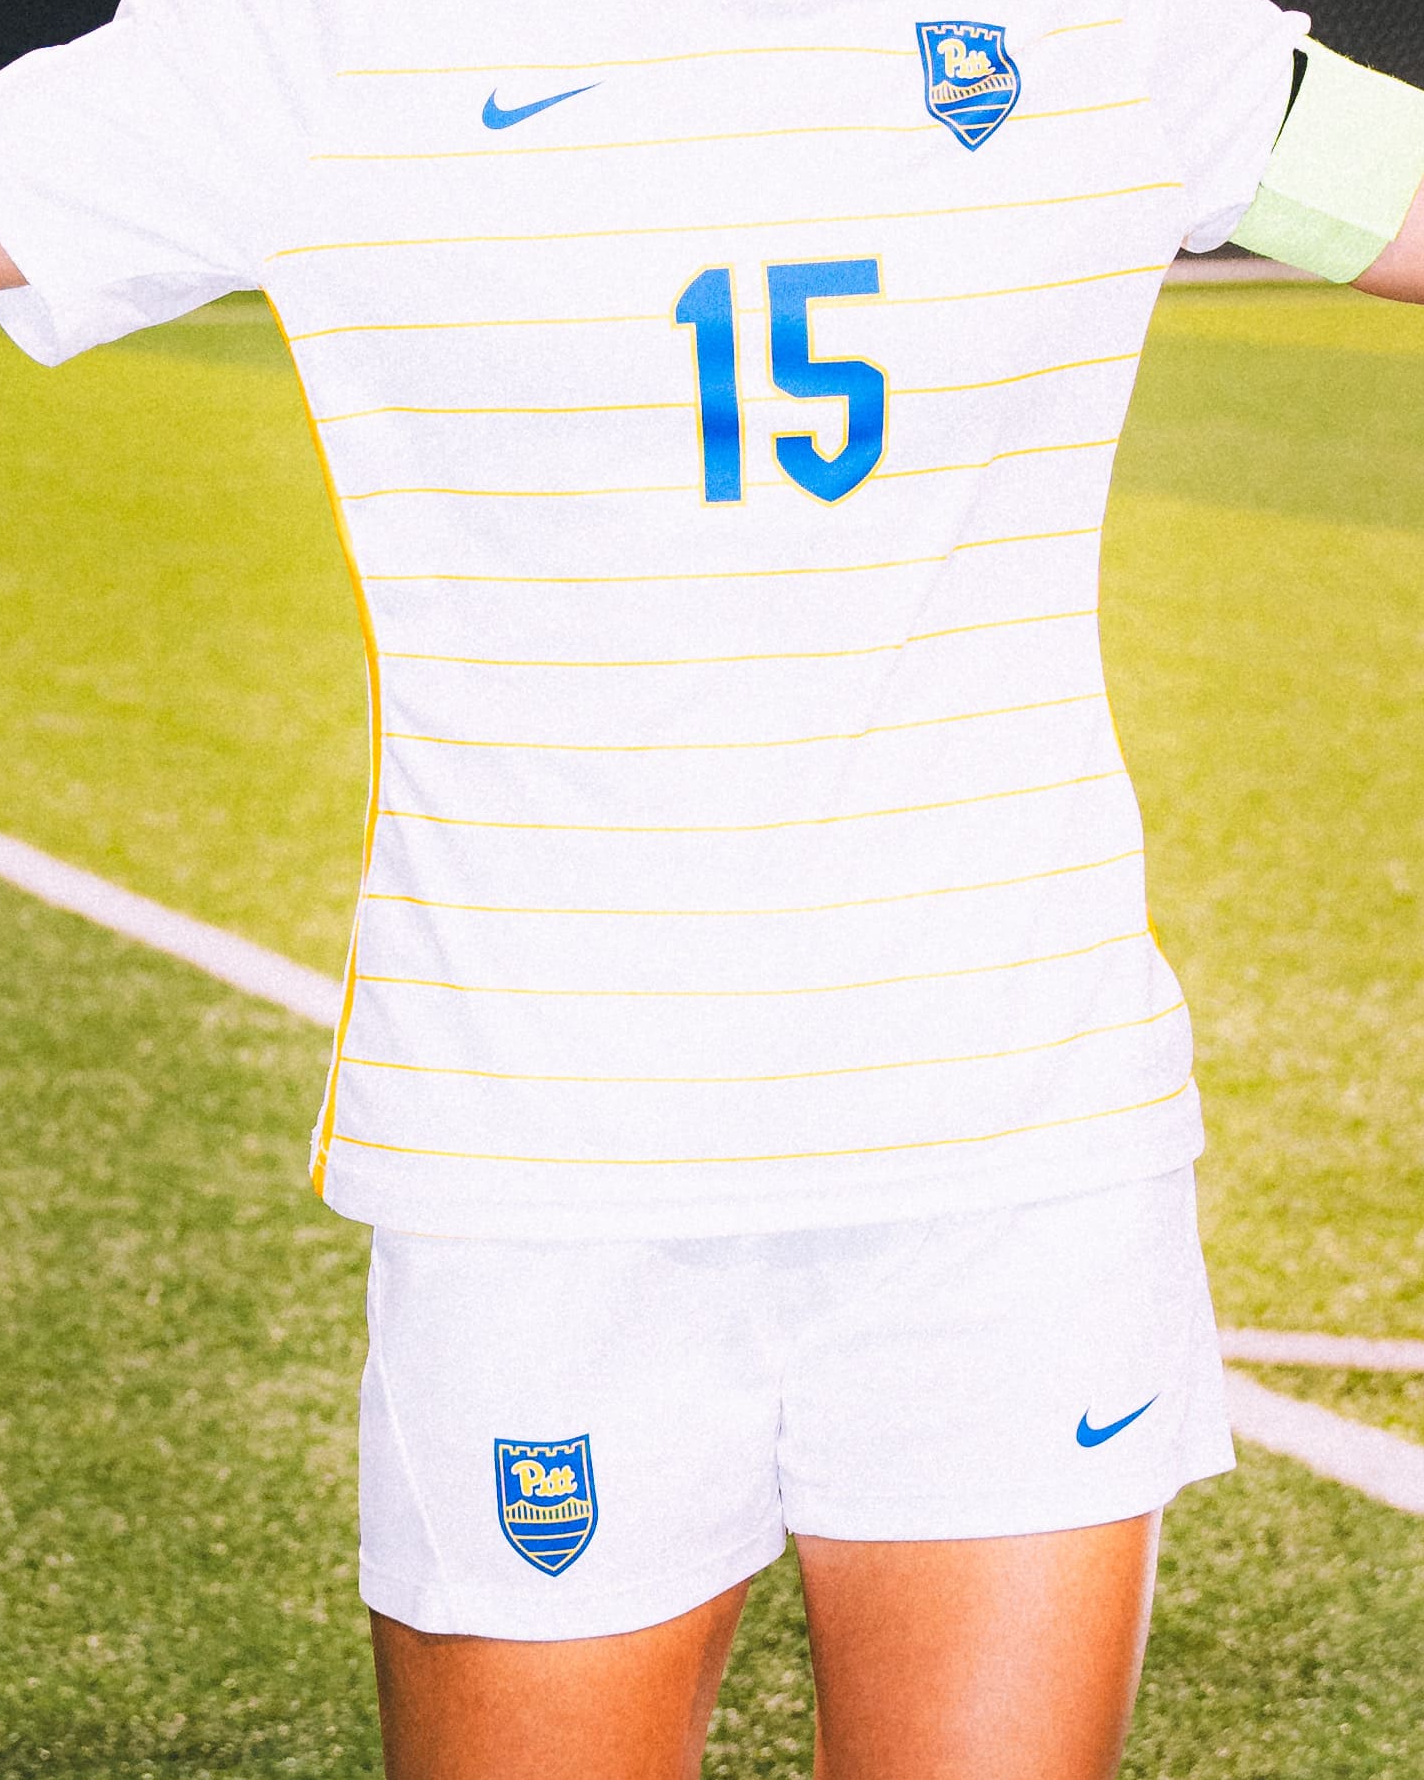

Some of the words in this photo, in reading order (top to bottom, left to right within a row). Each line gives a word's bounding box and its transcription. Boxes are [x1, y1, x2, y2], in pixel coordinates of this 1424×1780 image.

[937, 38, 996, 79] Pitt
[671, 254, 889, 507] 15
[511, 1460, 577, 1497] Pitt
